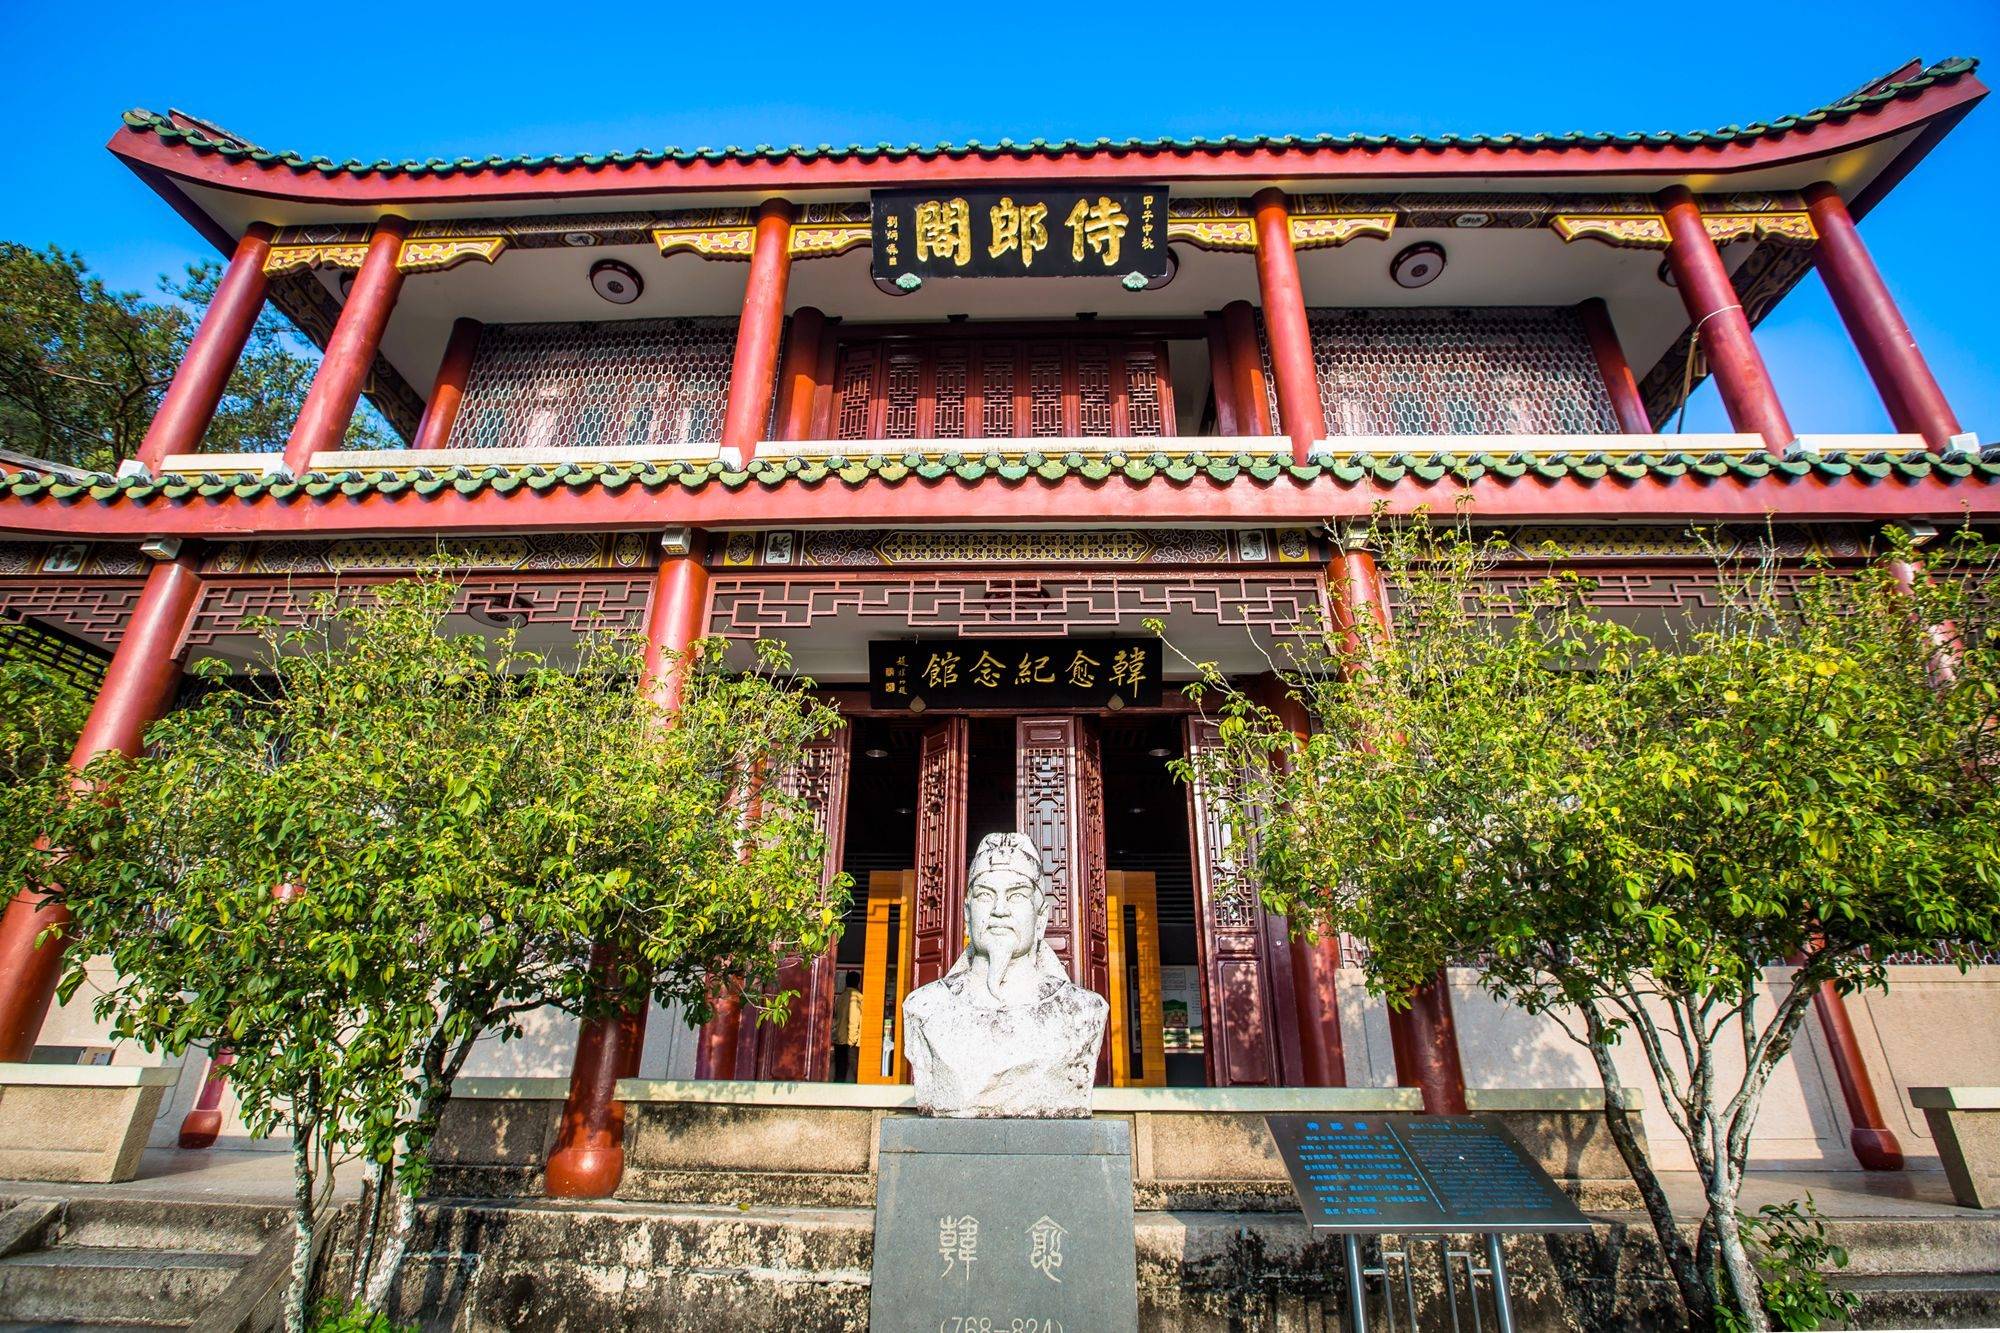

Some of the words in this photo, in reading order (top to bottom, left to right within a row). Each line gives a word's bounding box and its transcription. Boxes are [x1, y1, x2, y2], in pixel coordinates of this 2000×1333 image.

[914, 196, 1130, 268] 侍郎閣
[1141, 195, 1155, 250] 甲子中秋
[921, 646, 1147, 699] 韓愈紀念館
